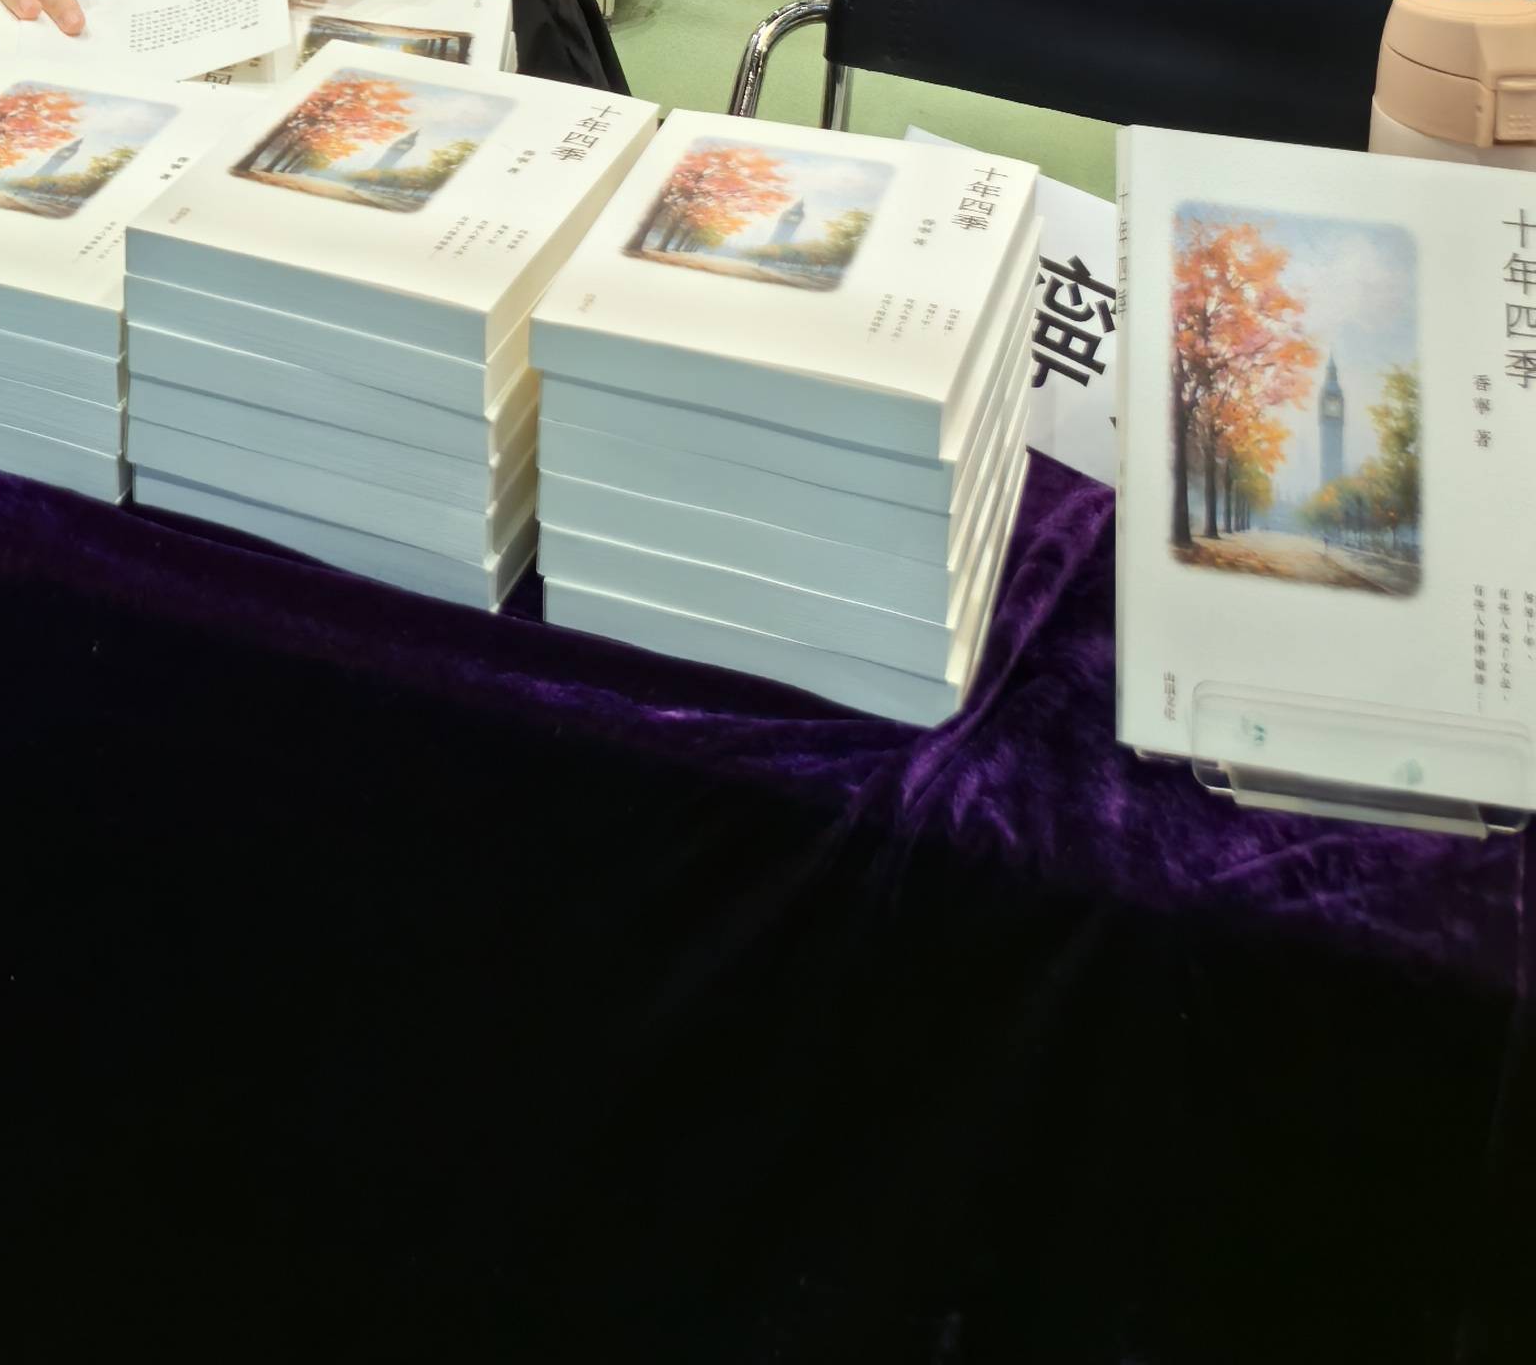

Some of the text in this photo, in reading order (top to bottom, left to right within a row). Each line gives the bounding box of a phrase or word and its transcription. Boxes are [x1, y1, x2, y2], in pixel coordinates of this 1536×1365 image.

[551, 104, 621, 164] 十年四季
[951, 167, 1009, 232] 十年四季
